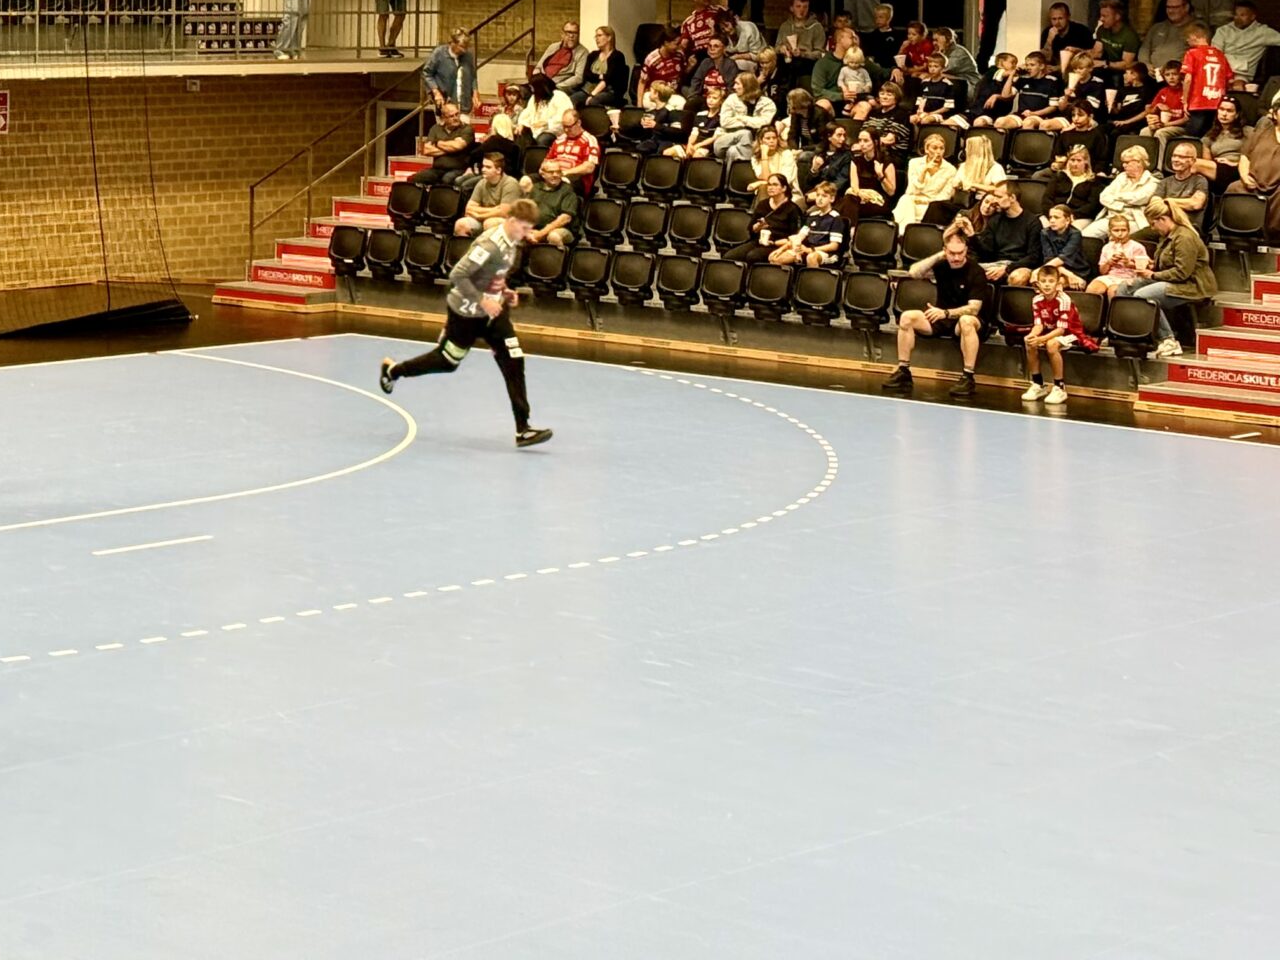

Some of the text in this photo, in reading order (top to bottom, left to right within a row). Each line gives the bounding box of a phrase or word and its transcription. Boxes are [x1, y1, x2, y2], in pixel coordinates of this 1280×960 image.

[1203, 62, 1221, 86] 17
[459, 298, 478, 315] 24
[1242, 312, 1280, 325] FREDER
